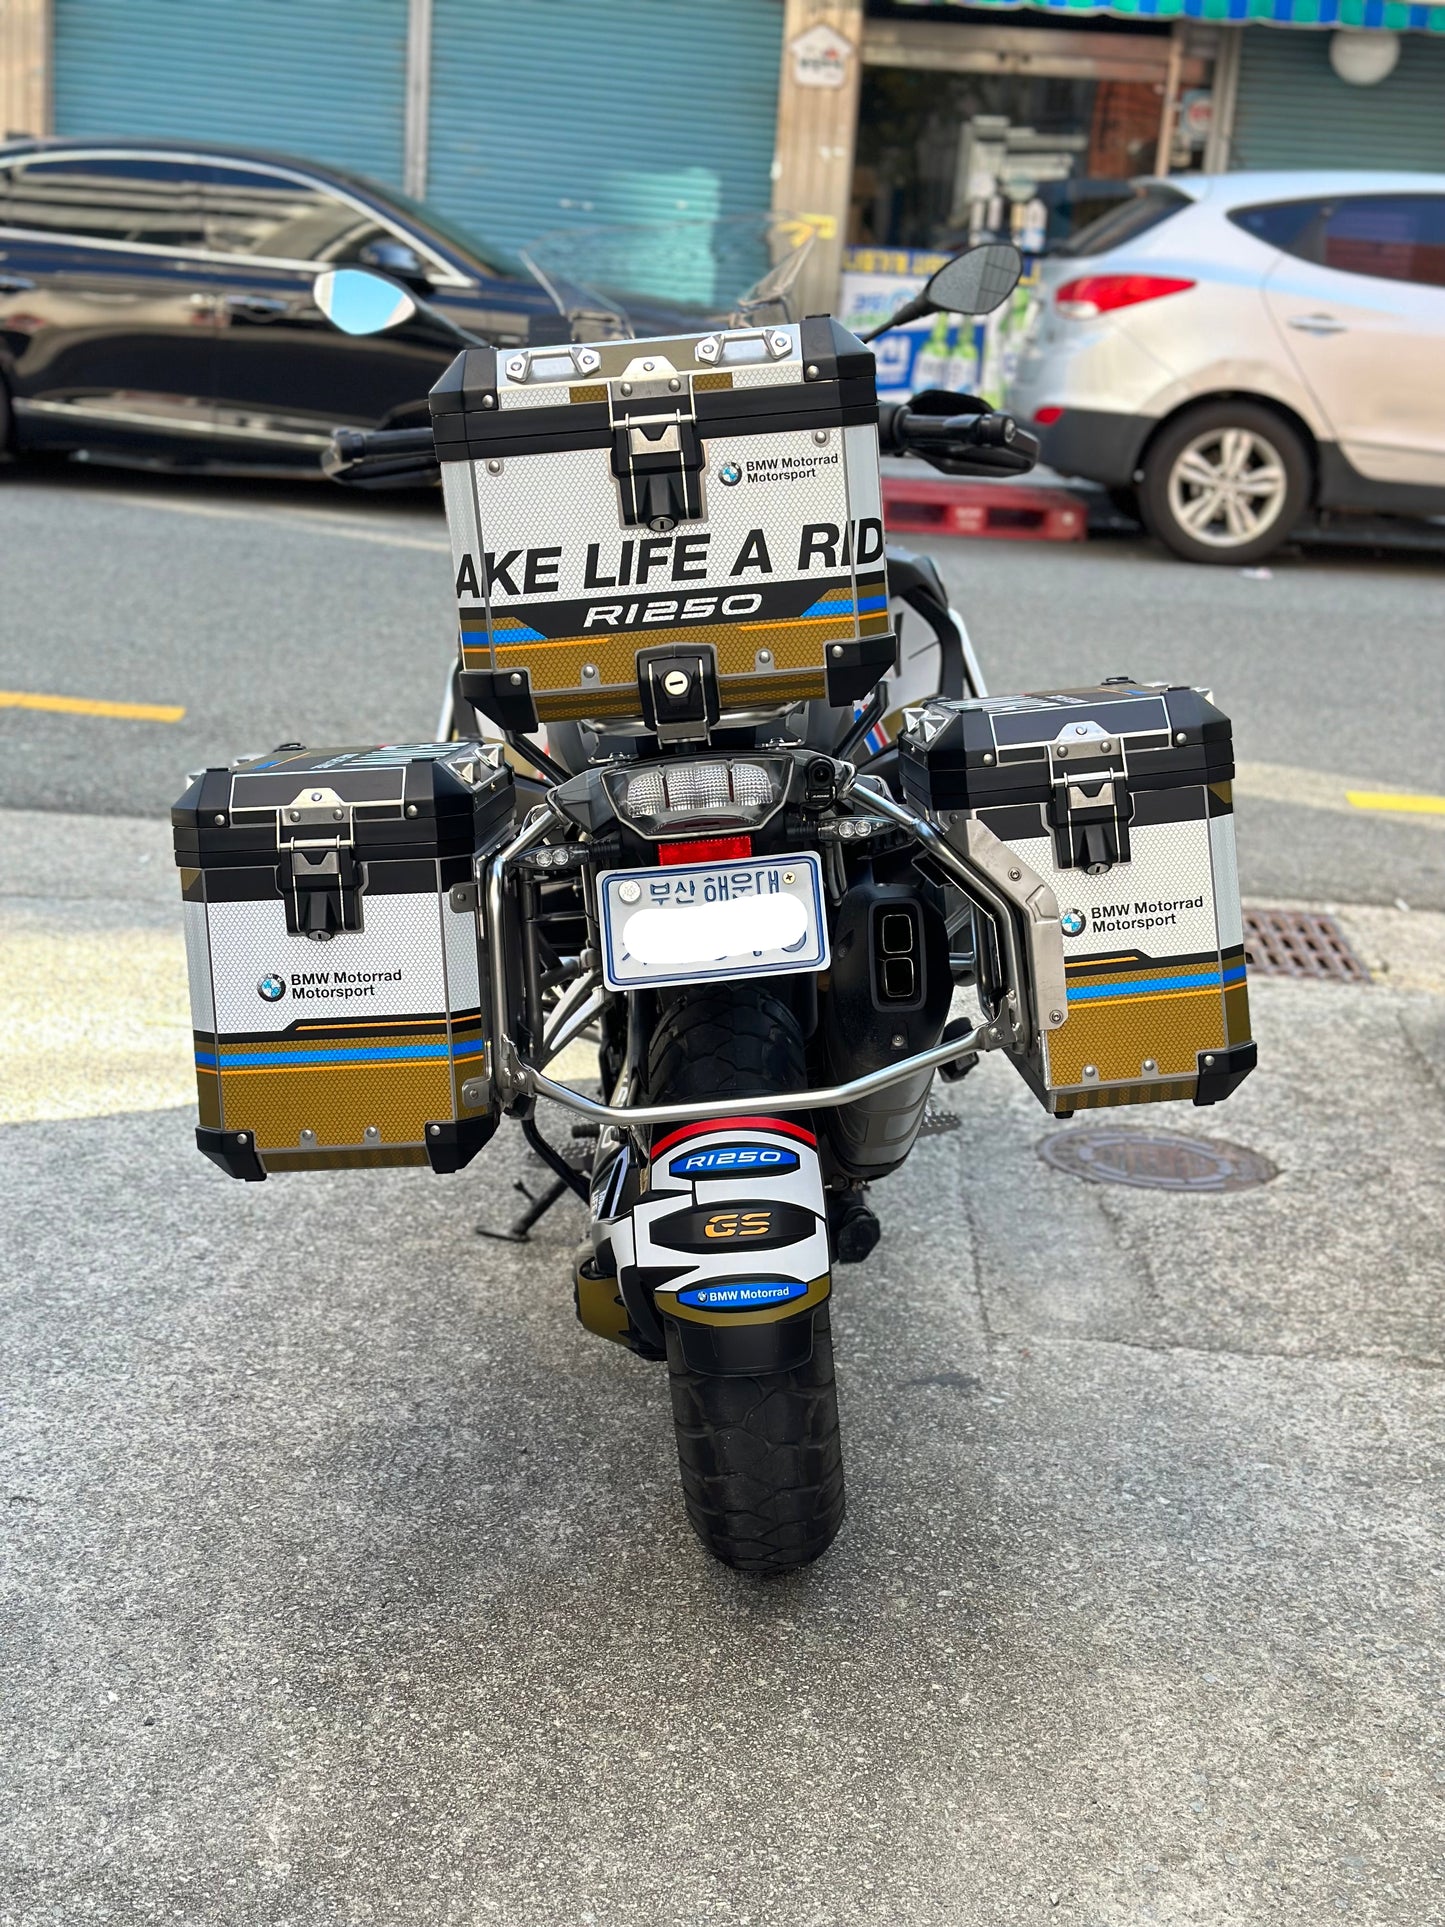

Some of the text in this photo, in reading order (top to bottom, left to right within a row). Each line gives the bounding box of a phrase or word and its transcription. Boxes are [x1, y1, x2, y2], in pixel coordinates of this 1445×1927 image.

[746, 453, 839, 471] BMW Motorrad
[747, 468, 816, 483] Motorsport
[583, 533, 712, 589] LIFE
[729, 528, 773, 577] A
[649, 880, 696, 906] 부산
[1091, 896, 1204, 919] BMW Motorrad
[1092, 913, 1177, 933] Motorsport
[291, 969, 402, 986] BMW Motorrad
[292, 984, 375, 999] Motorsport
[703, 1212, 772, 1238] GS
[709, 1286, 790, 1302] BMW Motorrad
